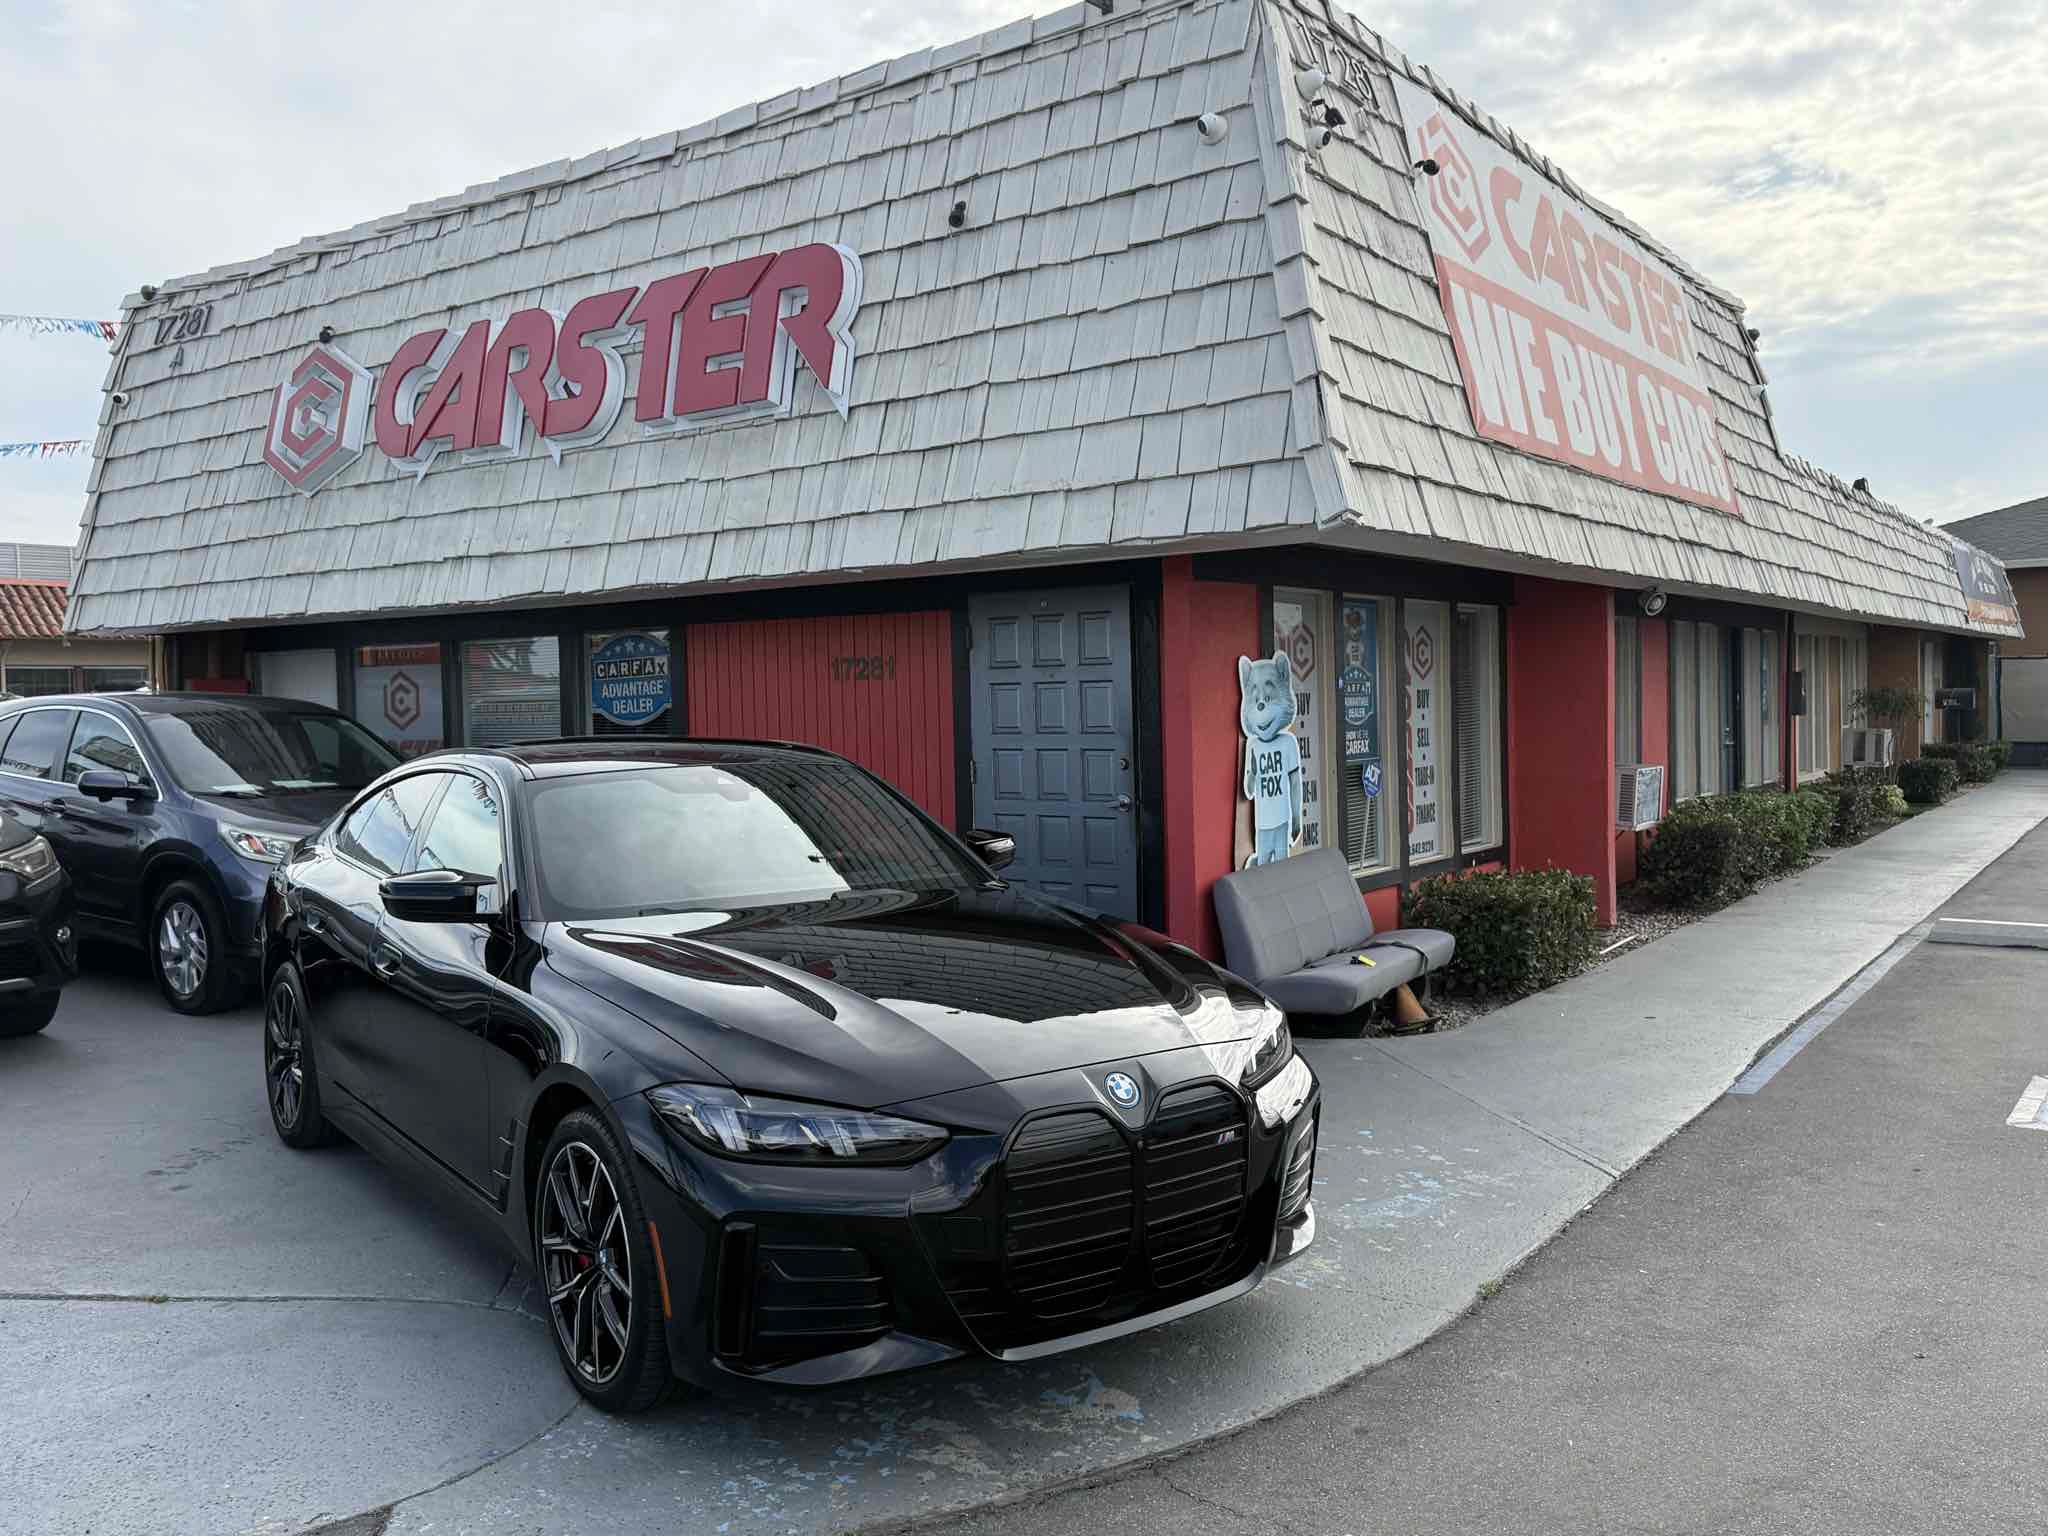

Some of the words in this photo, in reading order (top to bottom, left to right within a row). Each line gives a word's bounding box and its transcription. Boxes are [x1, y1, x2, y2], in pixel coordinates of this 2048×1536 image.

[1489, 166, 1698, 369] CARSTER
[154, 304, 214, 346] 17281
[373, 243, 850, 462] CARSTER
[1450, 281, 1559, 446] WE
[1546, 328, 1642, 474] BUY
[1638, 373, 1734, 502] CARS
[597, 657, 668, 678] CARFAX
[831, 655, 895, 681] 17281
[602, 680, 664, 698] ADVANTAGE
[1416, 688, 1431, 709] BUY
[612, 698, 654, 714] DEALER
[1345, 740, 1370, 756] CARFAX
[1416, 728, 1431, 748] SELL
[1259, 750, 1283, 776] CAR
[1260, 774, 1283, 798] FOX
[1415, 803, 1436, 825] FINANCE
